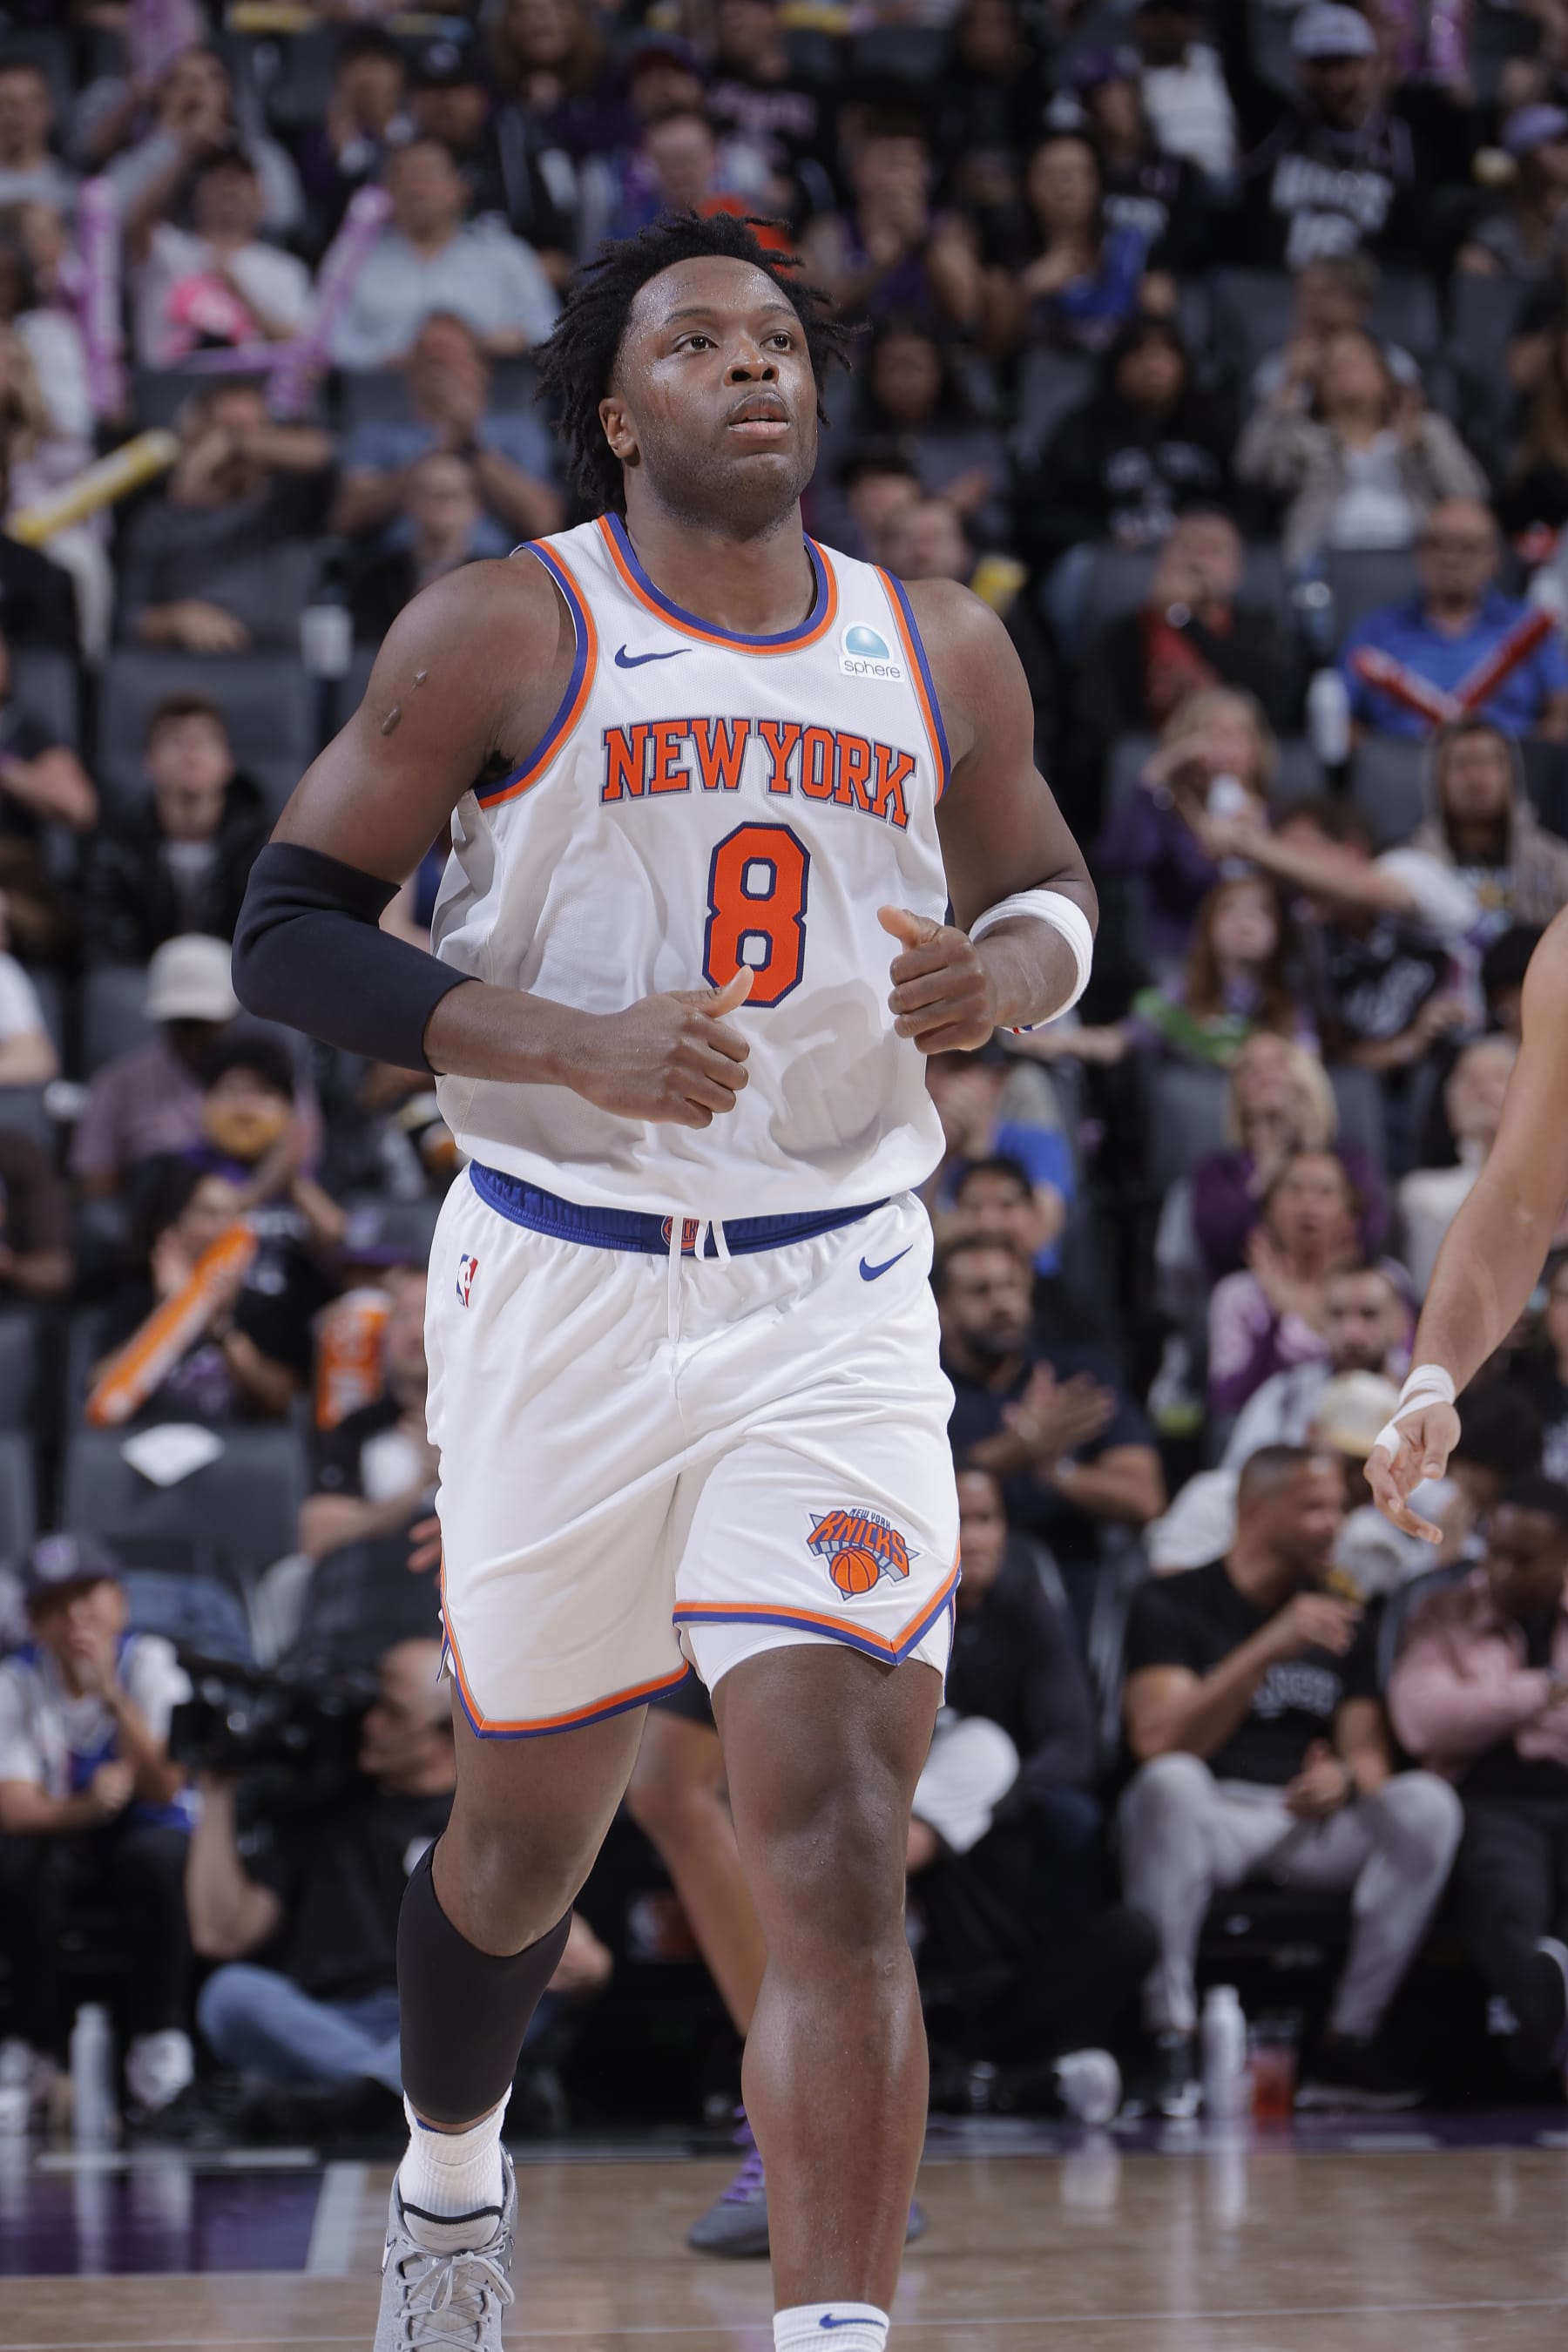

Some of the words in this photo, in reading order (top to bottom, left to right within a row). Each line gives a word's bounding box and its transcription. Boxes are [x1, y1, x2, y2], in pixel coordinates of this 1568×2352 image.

[843, 660, 901, 679] sphere
[600, 717, 752, 805] NEW
[756, 720, 917, 832] YORK
[702, 821, 811, 1009] 8
[807, 1510, 909, 1577] KNICKS
[849, 1508, 870, 1519] NEW
[870, 1511, 891, 1530] YORK
